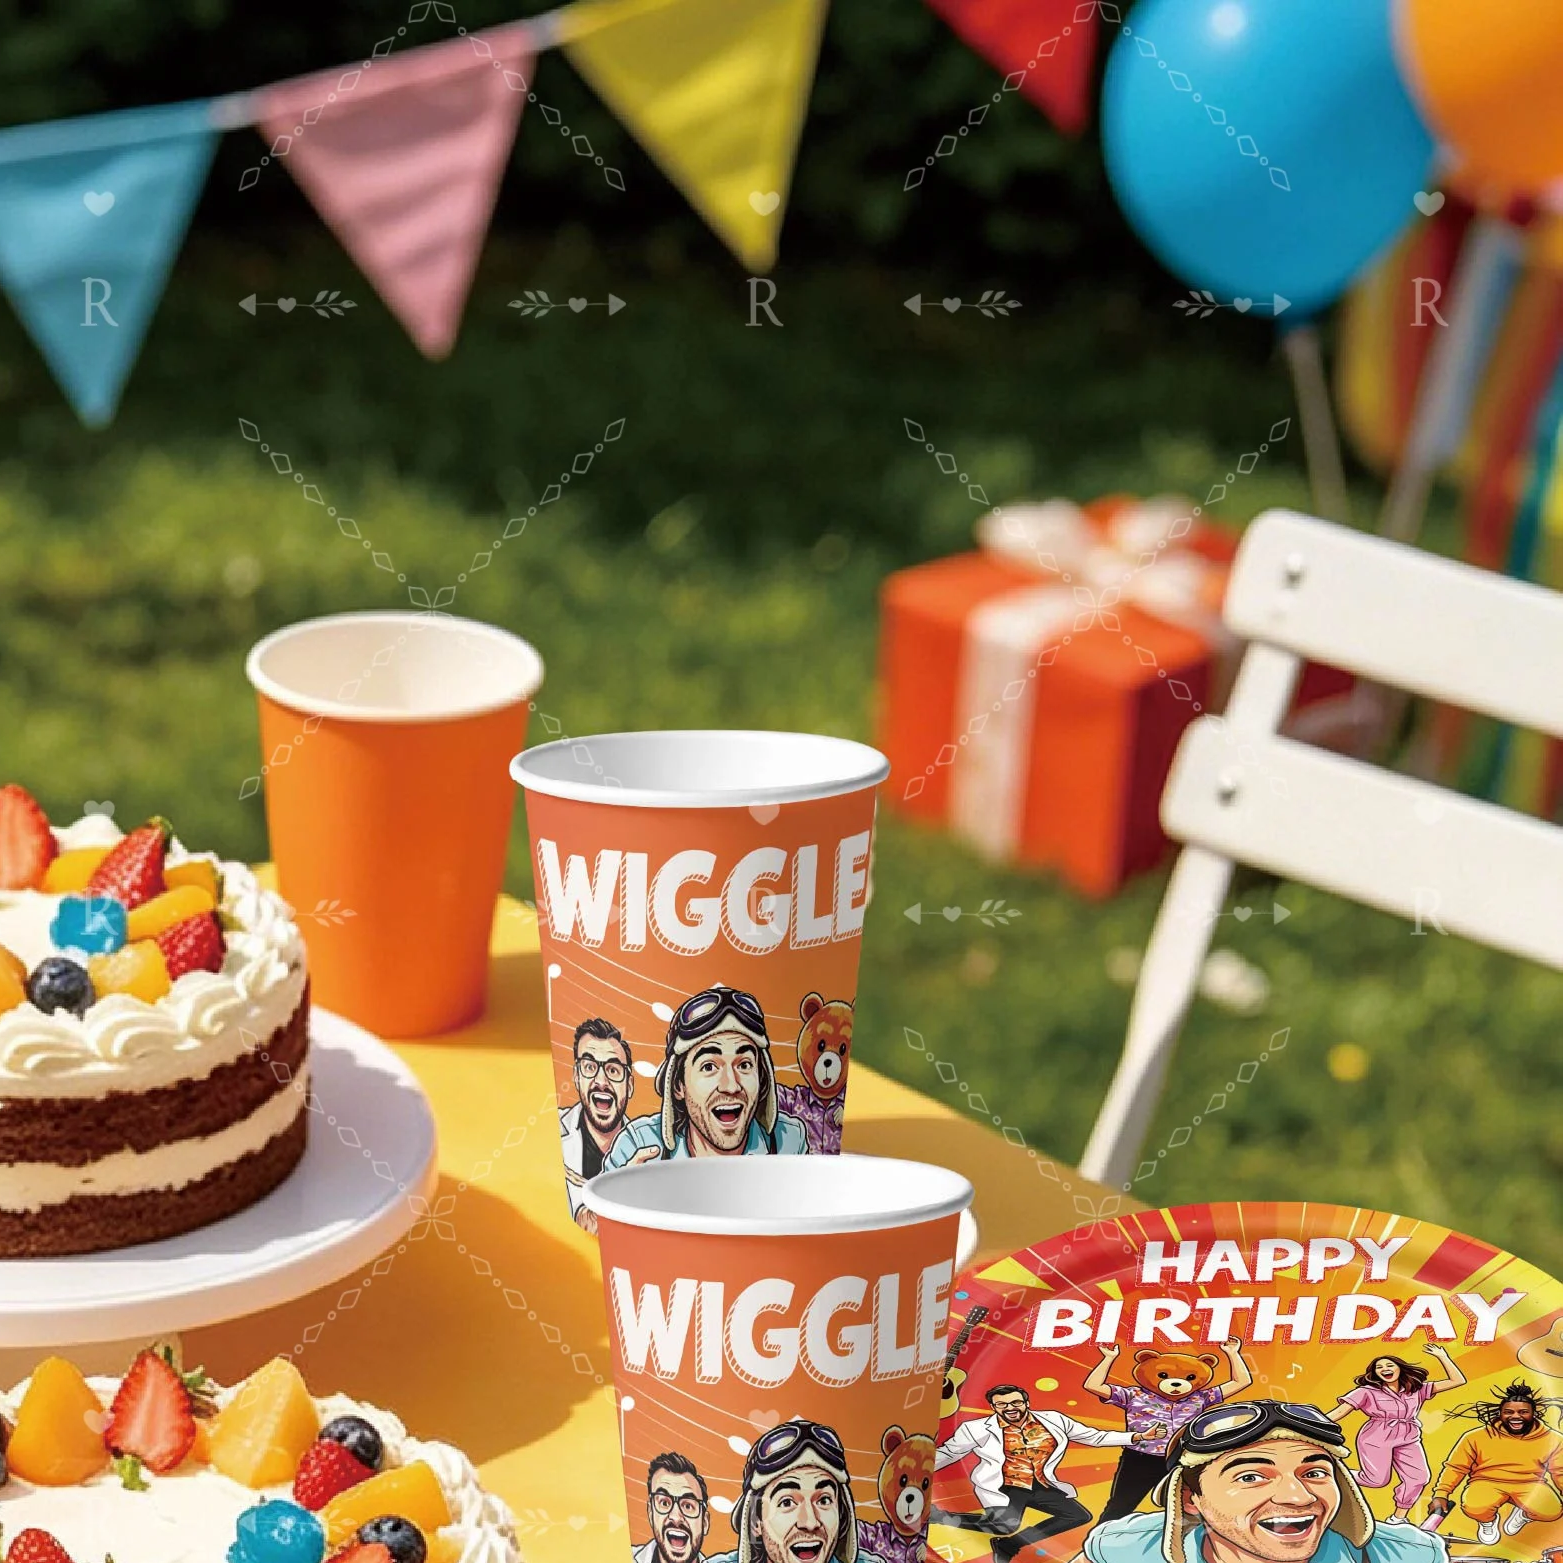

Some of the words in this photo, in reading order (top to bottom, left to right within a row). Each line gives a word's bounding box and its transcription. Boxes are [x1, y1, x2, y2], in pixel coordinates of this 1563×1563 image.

[537, 830, 870, 957] WIGGLE
[1135, 1236, 1412, 1287] HAPPY
[609, 1259, 954, 1389] WIGGLE
[1022, 1292, 1528, 1352] BIRTHDAY
